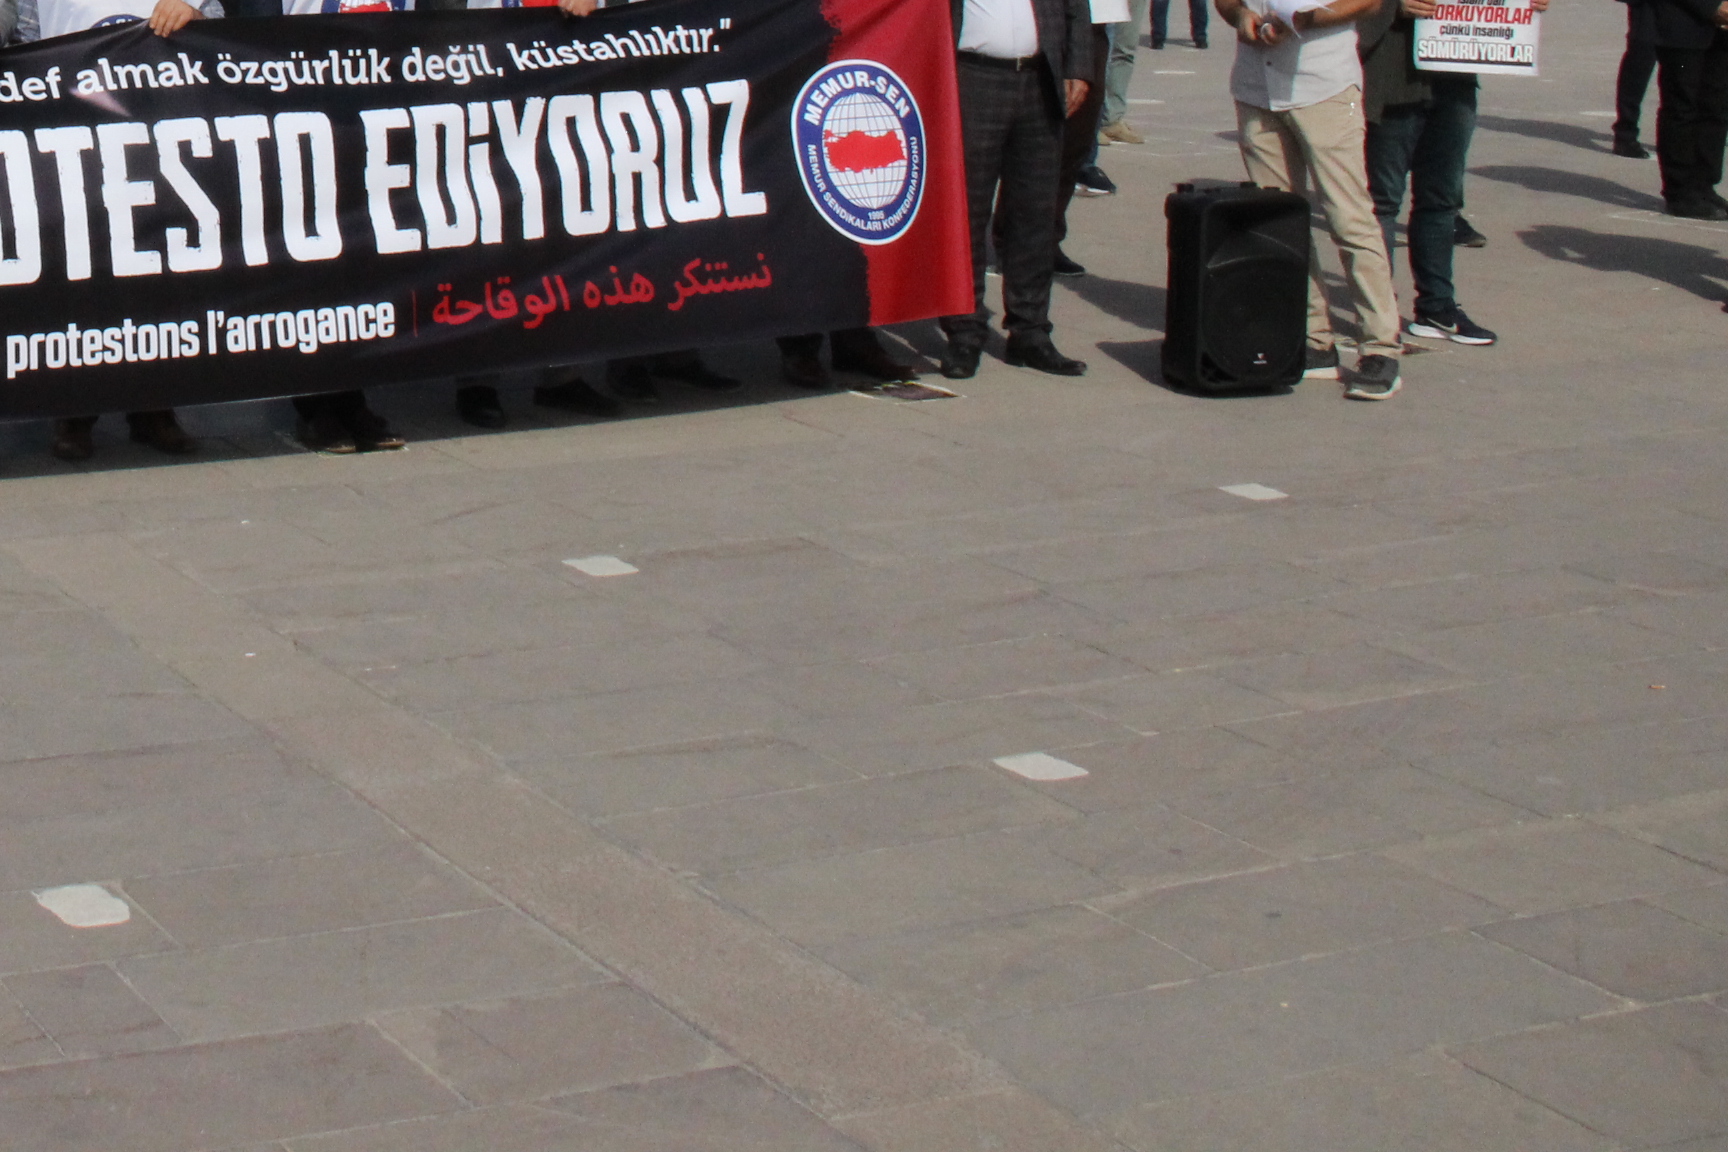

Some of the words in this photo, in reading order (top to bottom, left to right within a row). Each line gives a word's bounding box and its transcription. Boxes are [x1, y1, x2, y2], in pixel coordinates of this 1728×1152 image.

[1426, 4, 1534, 25] ORKUYORLAR
[1439, 25, 1470, 37] çünkü
[76, 53, 209, 96] almak
[217, 49, 391, 92] özgürlük
[402, 45, 504, 85] değil,
[1418, 36, 1534, 63] SÖMÜRÜYORLAR
[804, 70, 911, 126] MEMUR-SEN
[359, 79, 768, 255] EDİYORUZ
[808, 144, 827, 192] MEMUR
[882, 136, 920, 230] KONFEDERASYONU
[432, 275, 570, 329] الوقاحة
[583, 266, 656, 309] هذه
[668, 253, 773, 311] نستنكر
[6, 319, 200, 378] protestons
